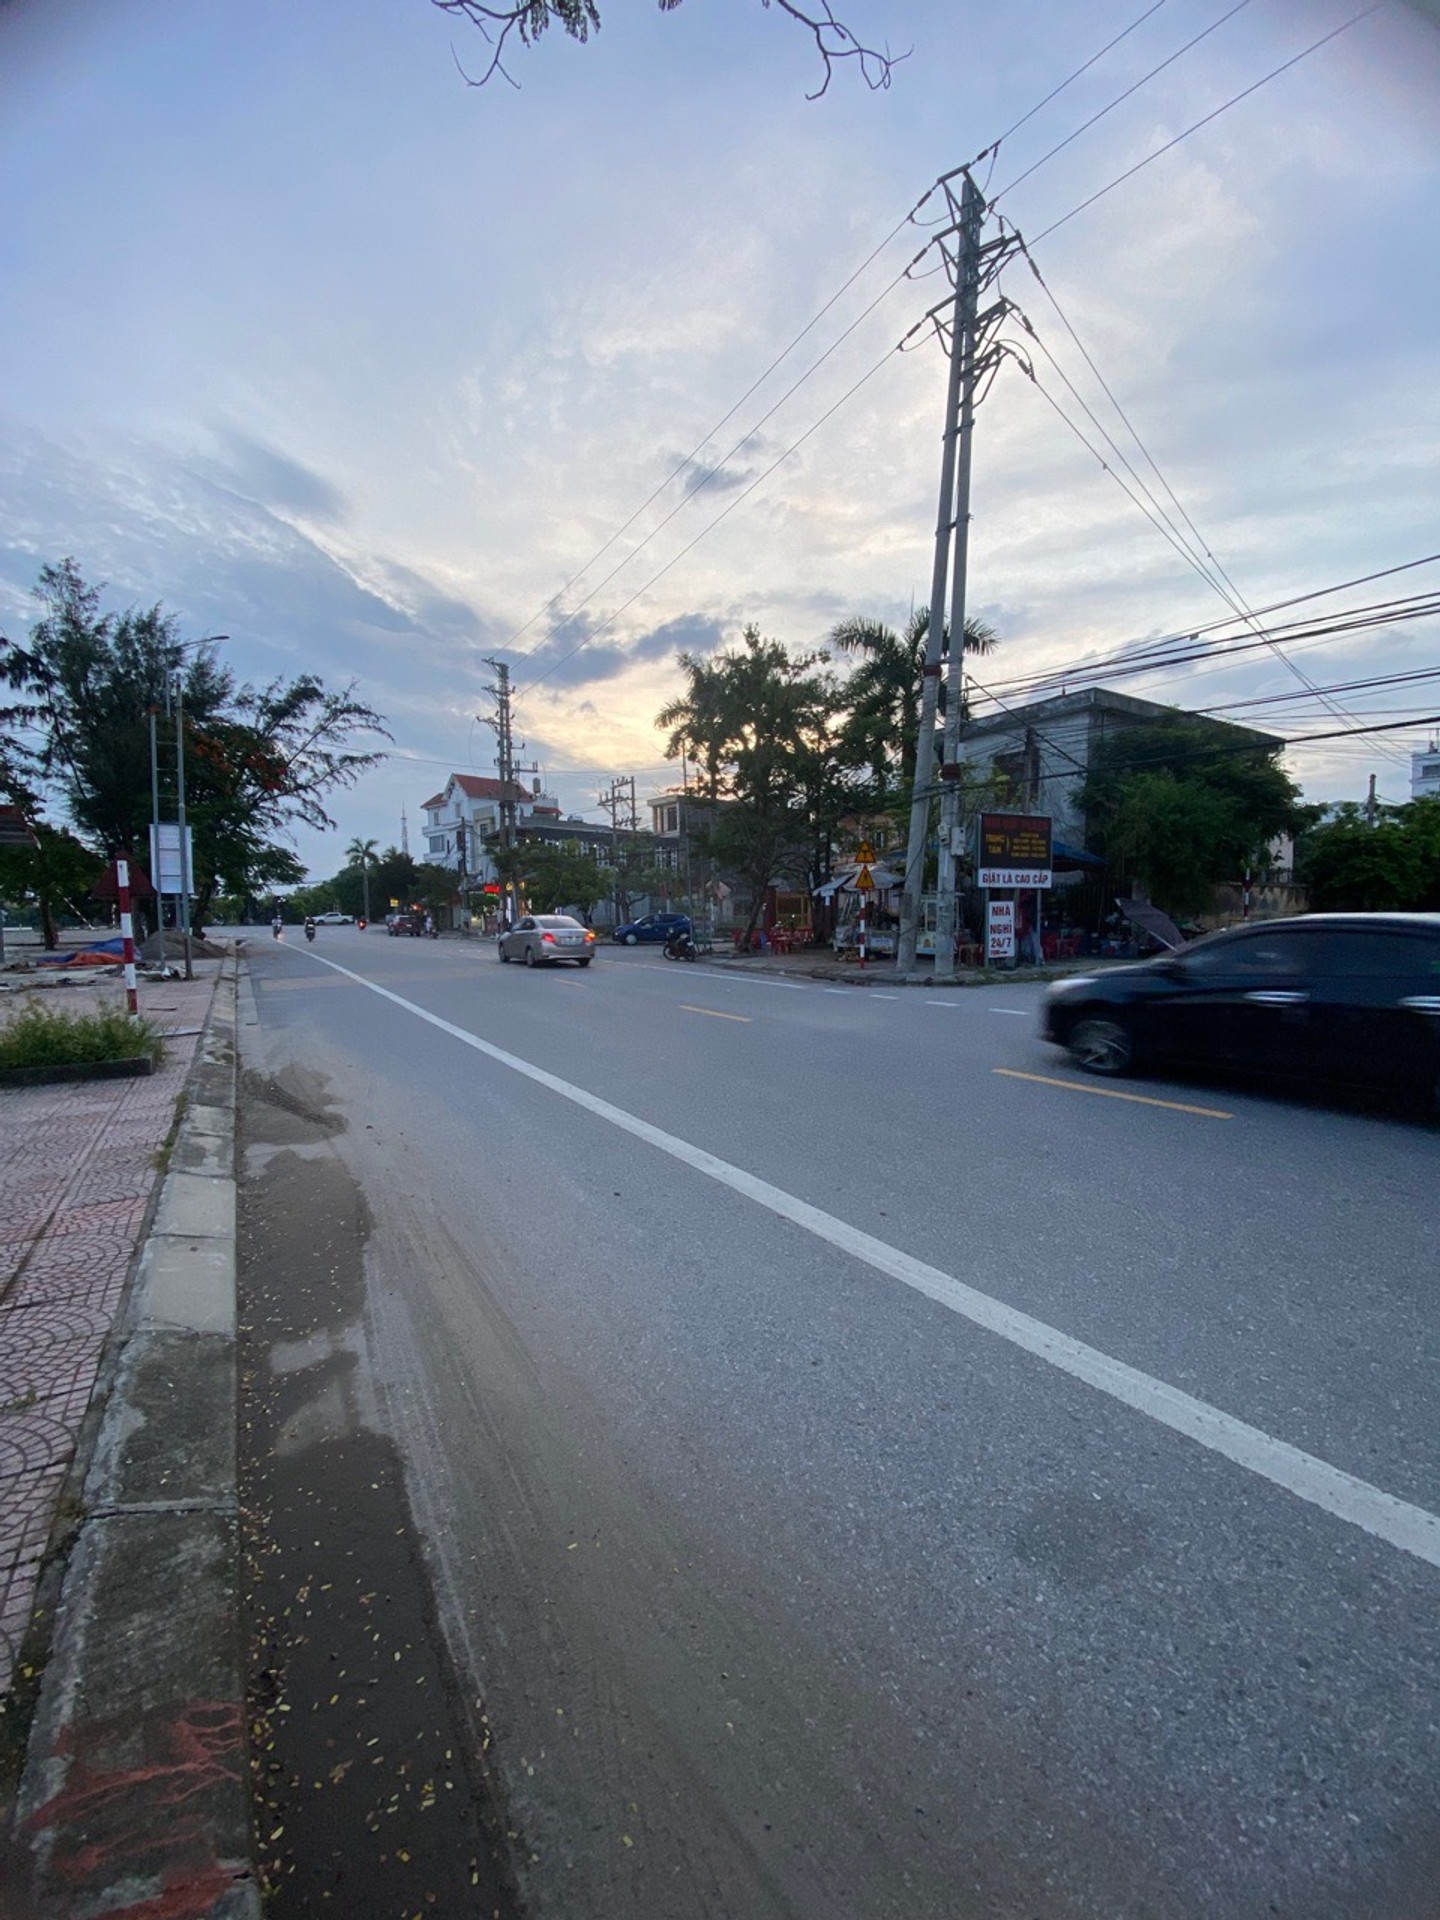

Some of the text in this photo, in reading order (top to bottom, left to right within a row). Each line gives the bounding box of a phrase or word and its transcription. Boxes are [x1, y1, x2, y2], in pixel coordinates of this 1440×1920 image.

[1002, 872, 1012, 884] LÀ
[1015, 874, 1030, 885] CAO
[991, 904, 1011, 917] NHÀ
[991, 937, 1011, 948] 24/7
